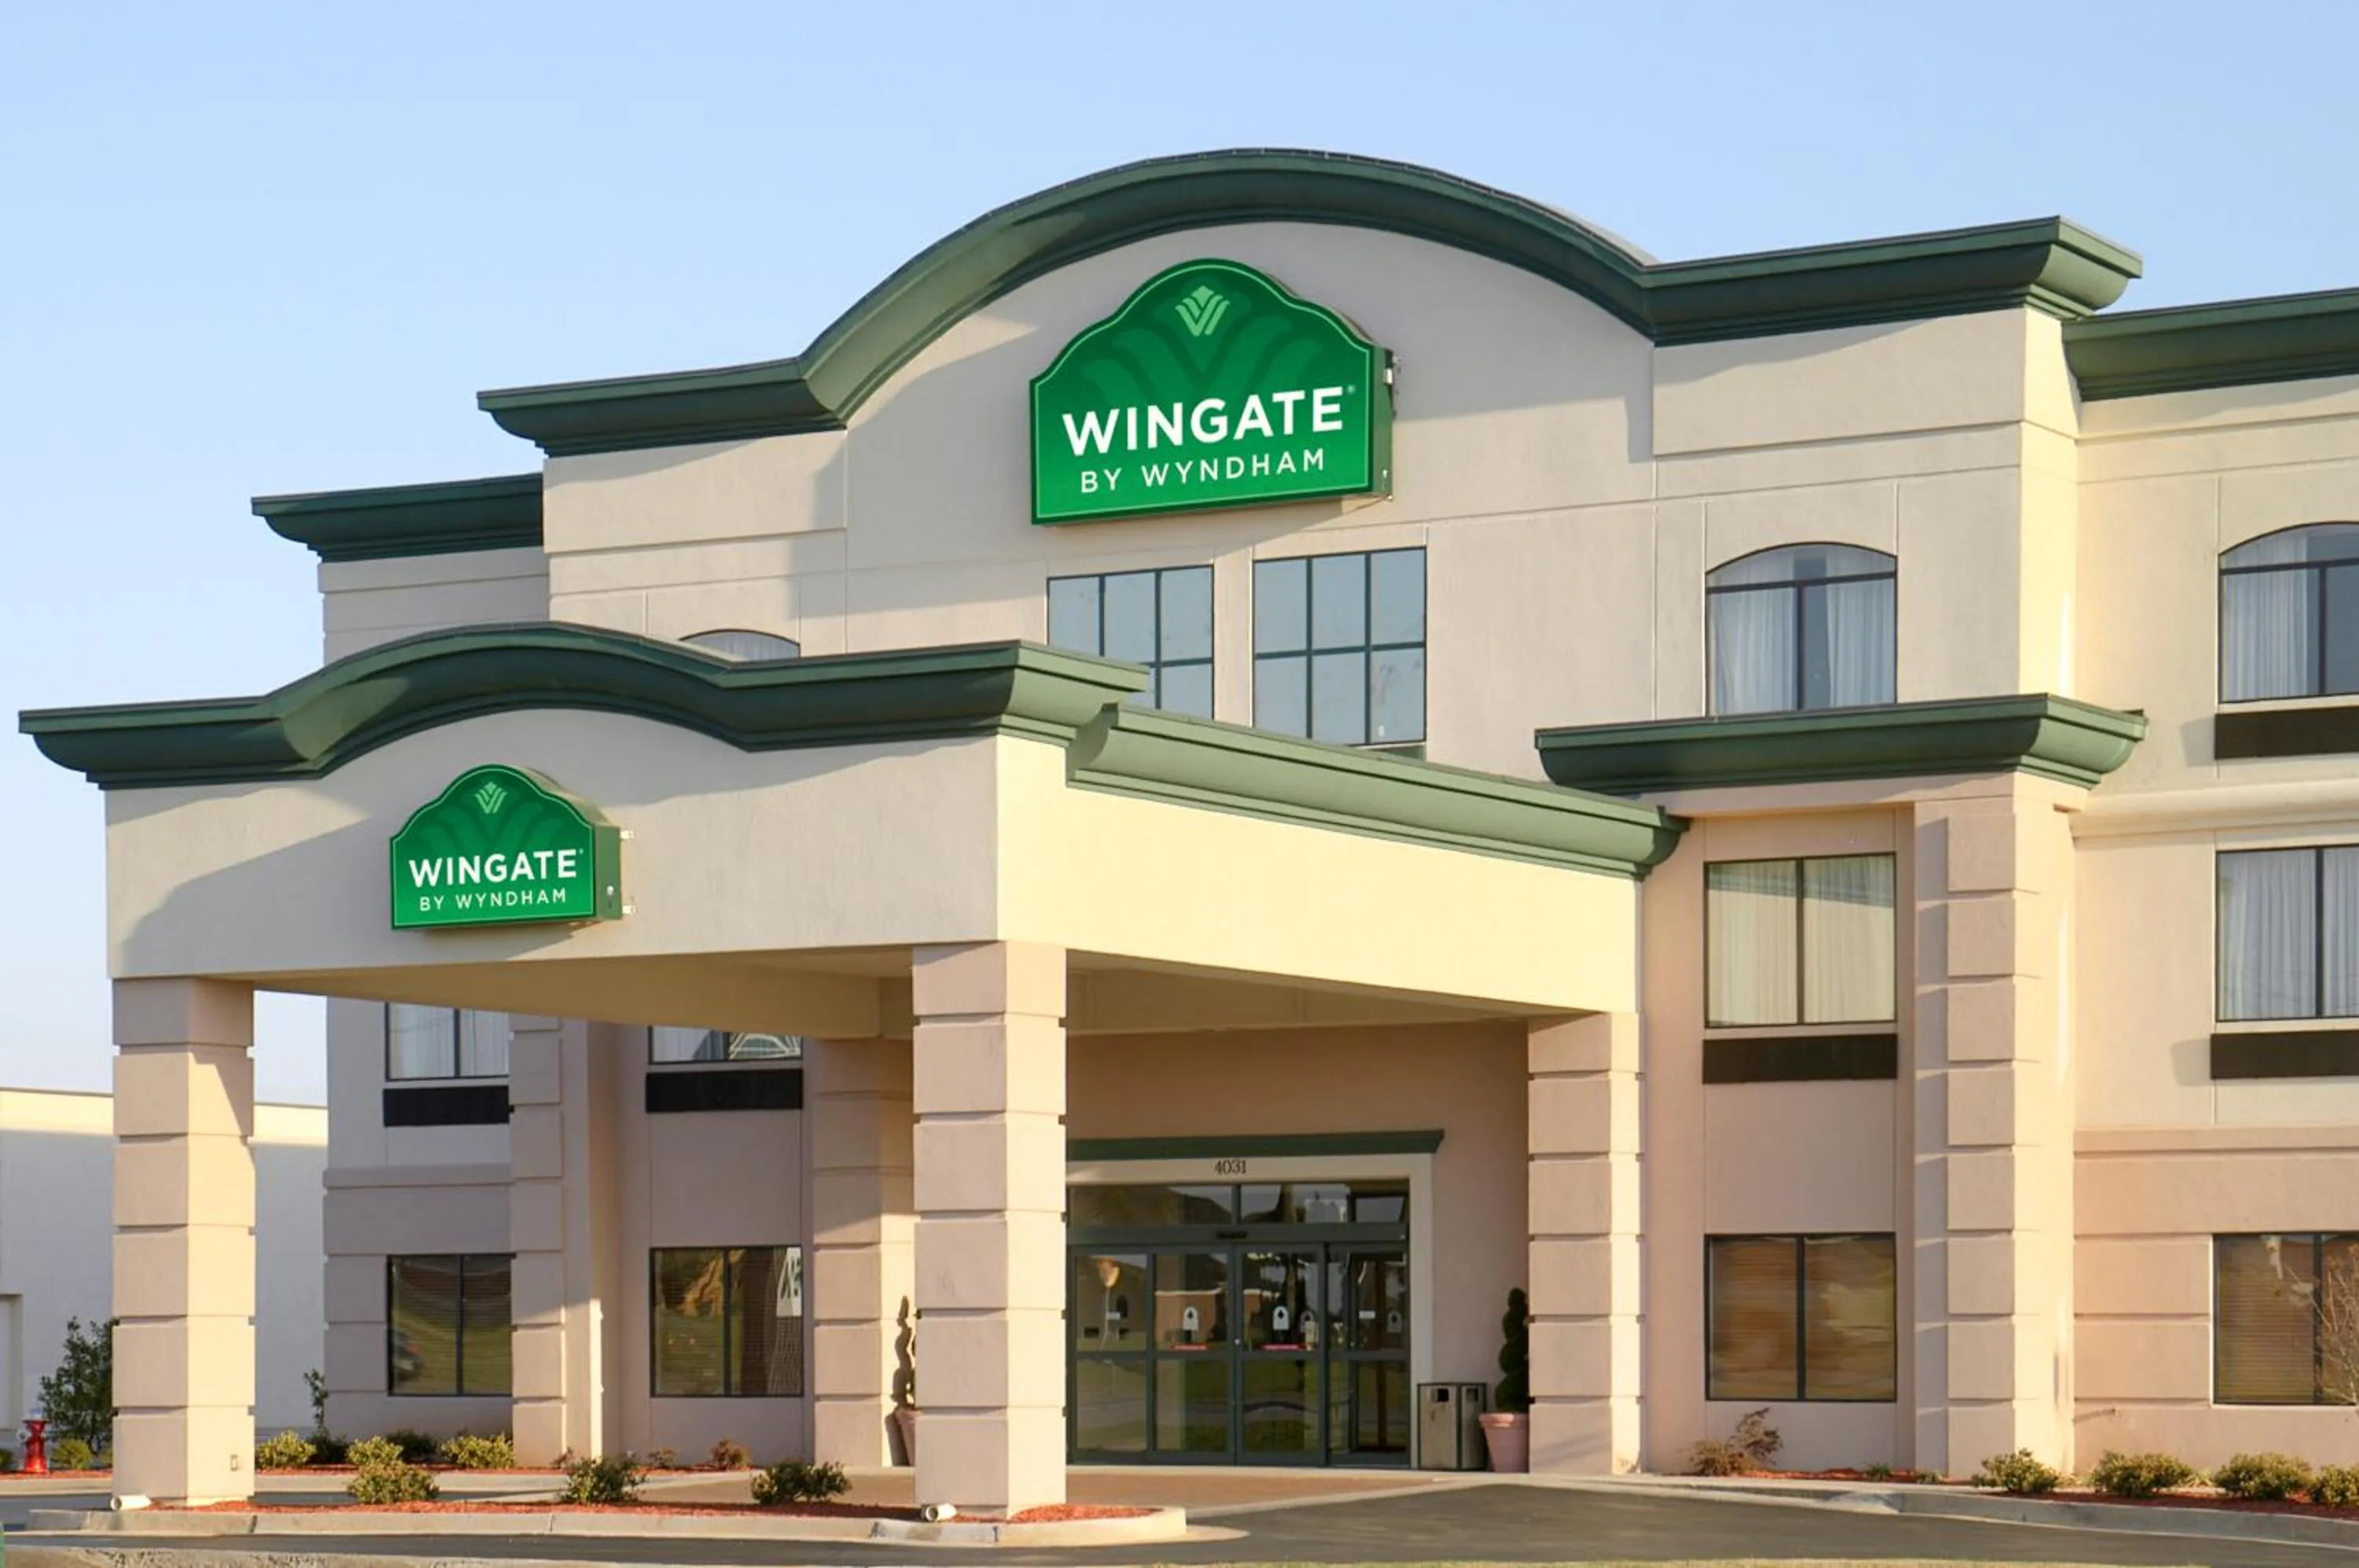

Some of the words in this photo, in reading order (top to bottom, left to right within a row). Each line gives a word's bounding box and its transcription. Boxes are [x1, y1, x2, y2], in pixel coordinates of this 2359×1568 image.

[1062, 386, 1343, 457] WINGATE
[1081, 467, 1122, 493] BY
[1141, 448, 1324, 488] WYNDHAM
[408, 848, 577, 888] WINGATE
[419, 895, 444, 912] BY
[455, 888, 566, 910] WYNDHAM
[1215, 1159, 1246, 1176] 4031
